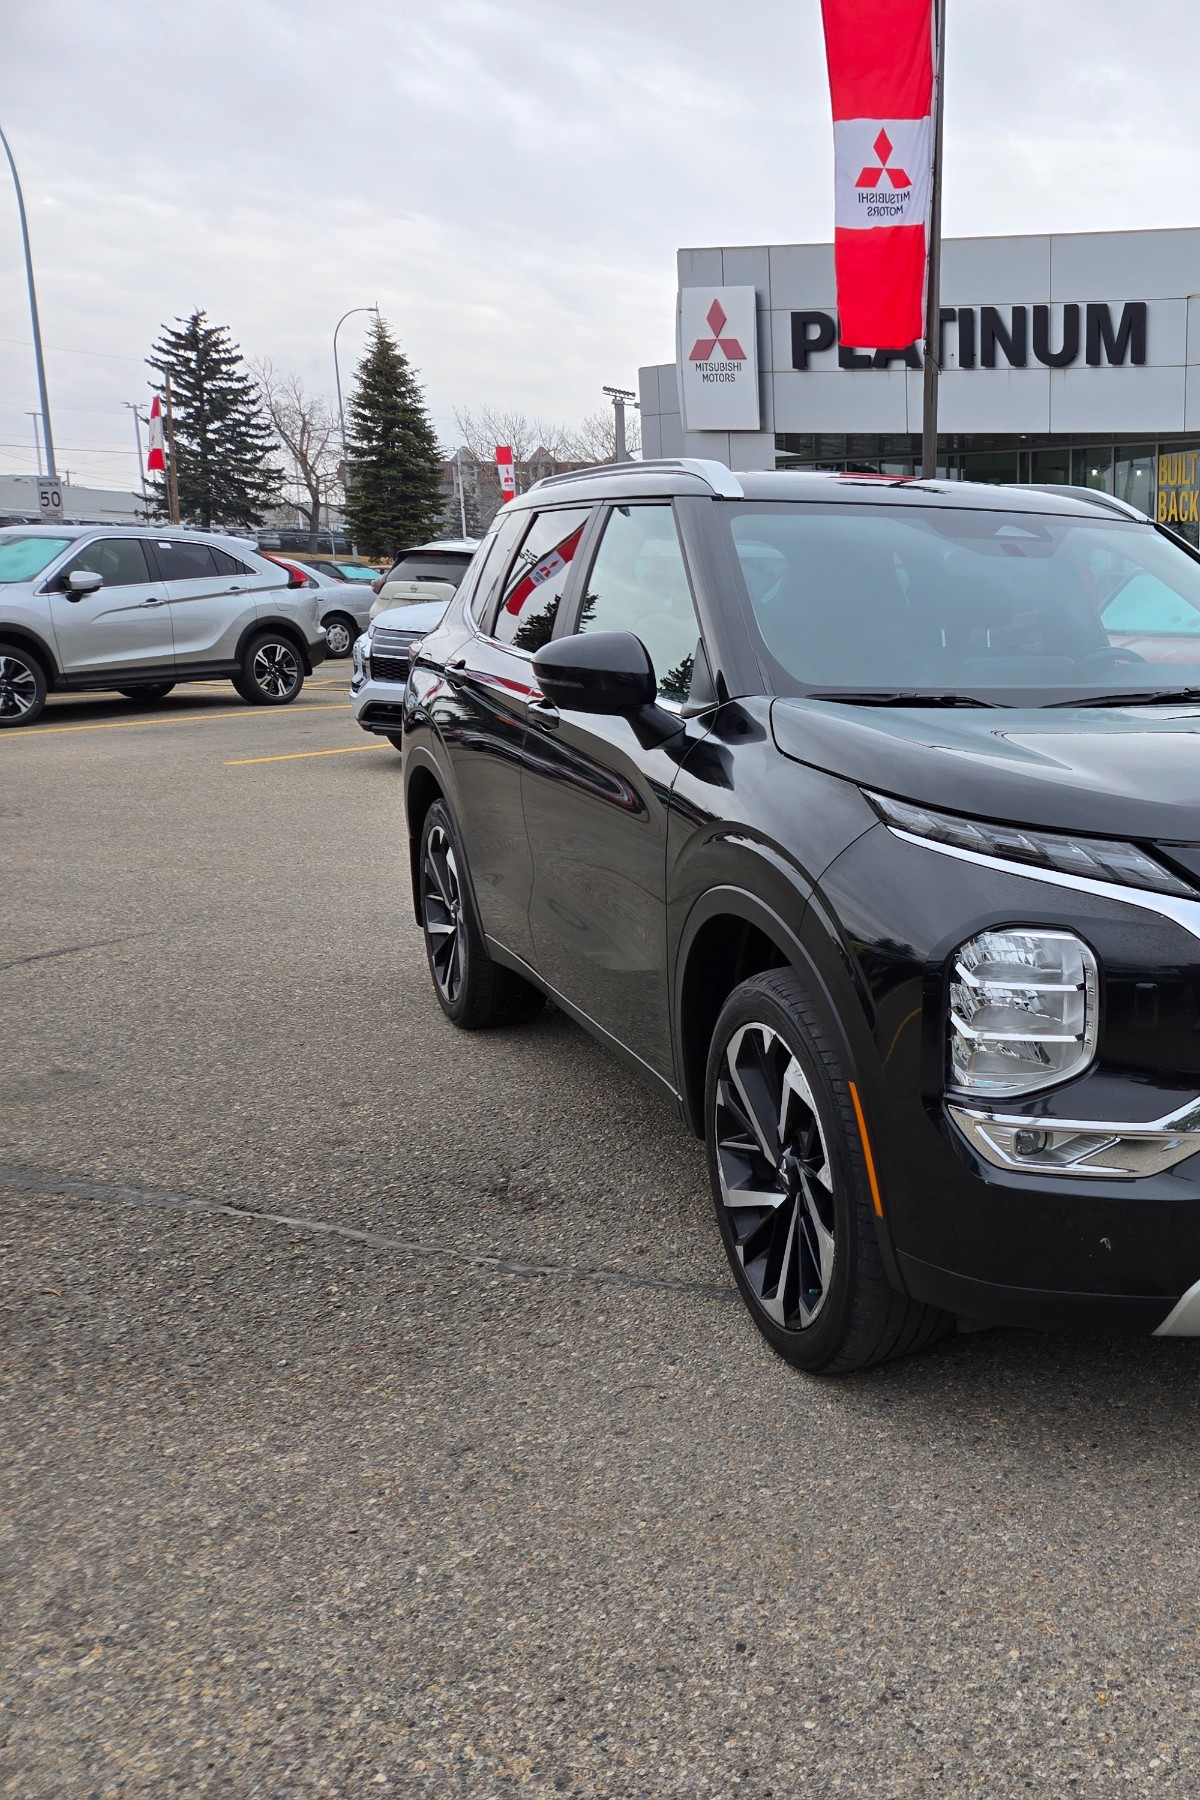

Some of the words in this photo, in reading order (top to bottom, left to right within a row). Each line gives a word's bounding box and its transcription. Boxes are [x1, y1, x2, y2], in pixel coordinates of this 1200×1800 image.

[695, 362, 742, 372] MITSUBISHI
[702, 373, 736, 383] MOTORS
[1158, 453, 1199, 486] BUILT
[40, 491, 61, 507] 50
